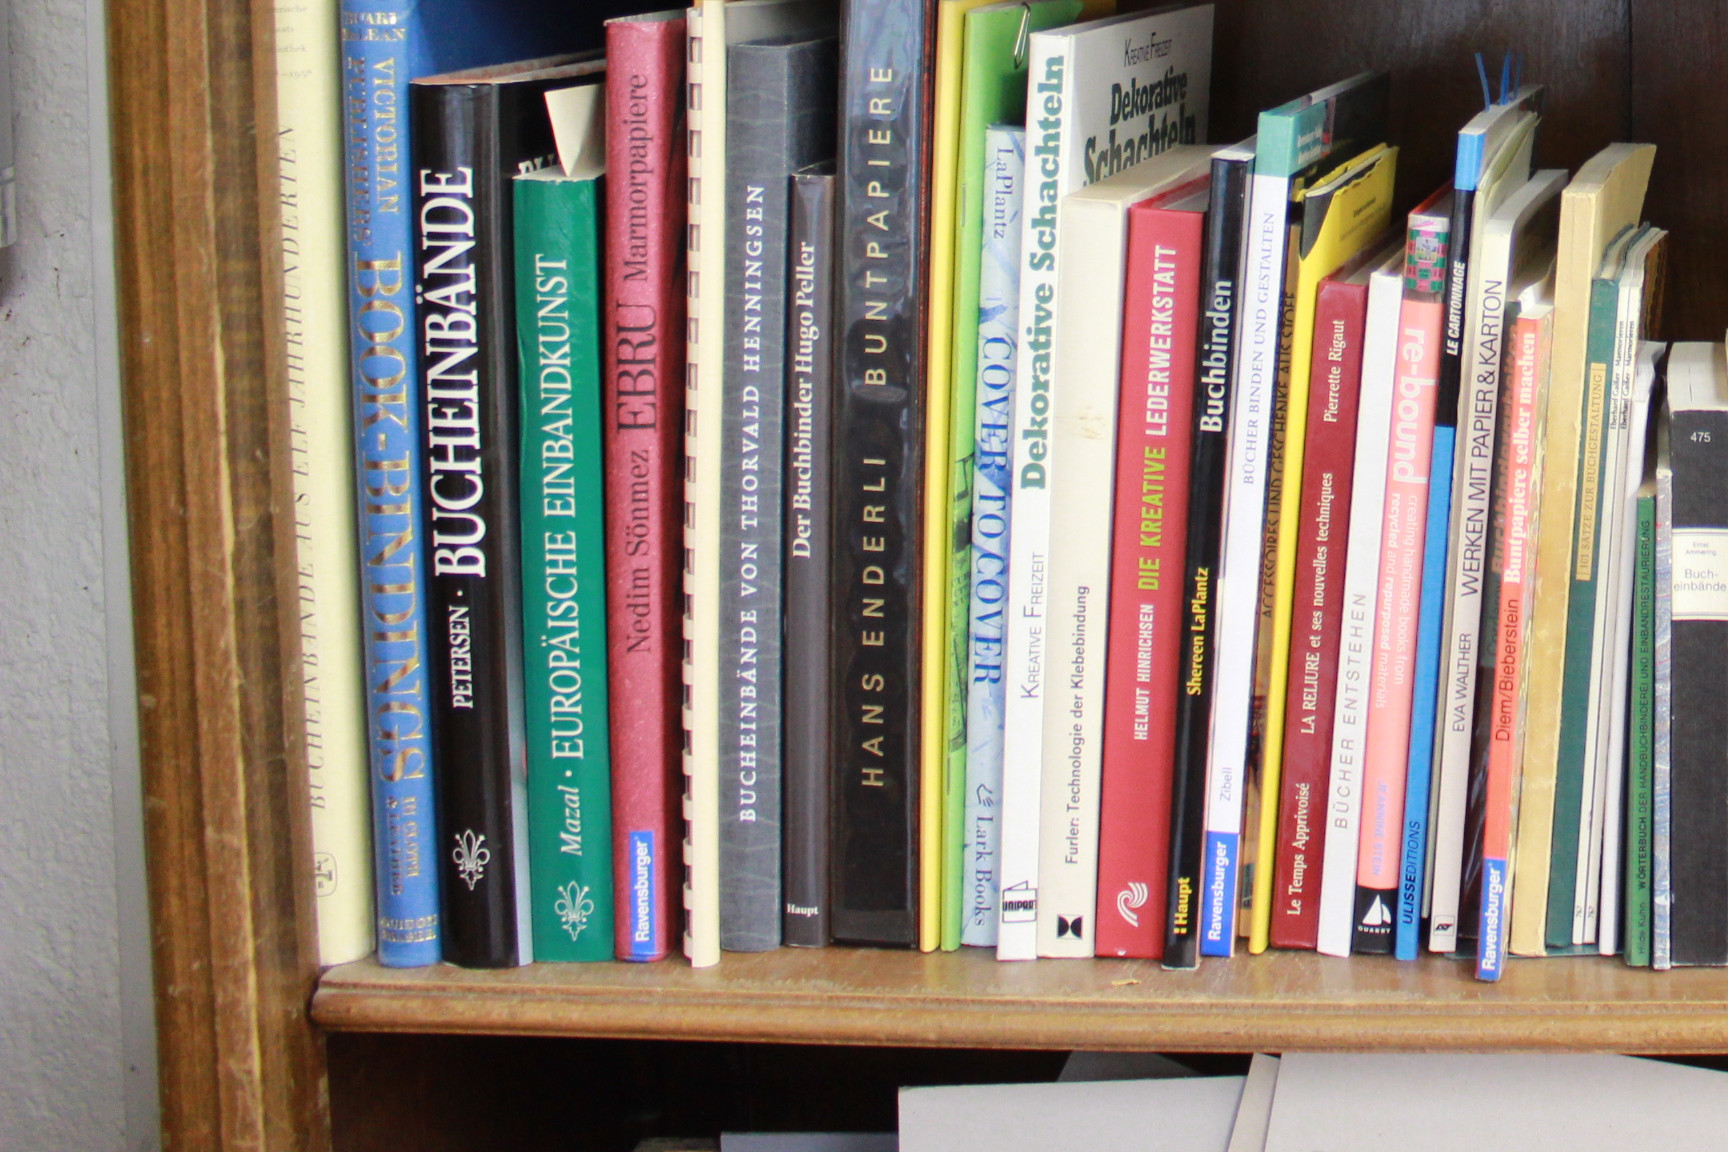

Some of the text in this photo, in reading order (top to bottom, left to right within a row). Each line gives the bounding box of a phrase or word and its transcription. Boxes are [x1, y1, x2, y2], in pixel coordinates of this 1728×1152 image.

[371, 56, 400, 217] VICTORIAN
[992, 147, 1014, 241] LaPlantz
[1110, 65, 1188, 126] Dekorative
[616, 73, 659, 655] Nedim Sönmez EBRU Marmorpapiere
[1020, 56, 1065, 491] Dekorative Schachteln
[1242, 211, 1276, 486] BÜCHER BINDEN UND GESTALTEN
[1446, 260, 1467, 356] LE CARTONNAGE
[416, 166, 487, 710] PETERSEN BUCHEINBÄNDE
[793, 241, 819, 559] Der Buchbinder Hugo Peller
[861, 66, 893, 788] HANS ENDERLI BUNTPAPIERE
[1133, 244, 1178, 741] HELMUT HINRICHSEN DIE KREATIVE LEDERWERKSTATT
[1186, 278, 1234, 697] Shereen LaPlantz Buchbinden
[1396, 327, 1438, 486] re-bound
[1586, 374, 1604, 483] BUCHGESTALTUNG
[1690, 431, 1711, 444] 475
[355, 250, 425, 783] BOOK-BINDINGS
[534, 253, 585, 858] Mazal EUROPÄISCHE EINBANDKUNST
[737, 184, 766, 824] BUCHEINBÄNDE VON THORVALD HENNINGSEN
[972, 335, 1013, 688] COVER TO COVER
[1397, 548, 1418, 614] handmade
[1452, 279, 1504, 733] EVA WALTHER WERKEN MIT PAPIER KARTON
[1495, 332, 1537, 743] Diem/Bieberstein Buntpapiere selber machen
[1673, 580, 1728, 593] einbände
[1684, 568, 1719, 580] Buch-
[1288, 319, 1347, 896] Temps Apprivoisé LA RELIURE nouvelles techniques Pierrette Rigaut
[1064, 584, 1091, 866] Furler: Technologie der Klebebindung
[1219, 765, 1233, 803] Zibell
[1334, 592, 1368, 830] BÜCHER ENTSTEHEN
[635, 838, 652, 943] Ravensburger
[786, 904, 819, 918] Haupt
[974, 815, 994, 927] Lark Books
[1206, 839, 1229, 943] Ravensburger
[1403, 820, 1421, 926] ULISSEDITIONS
[1482, 865, 1503, 972] Ravensburger
